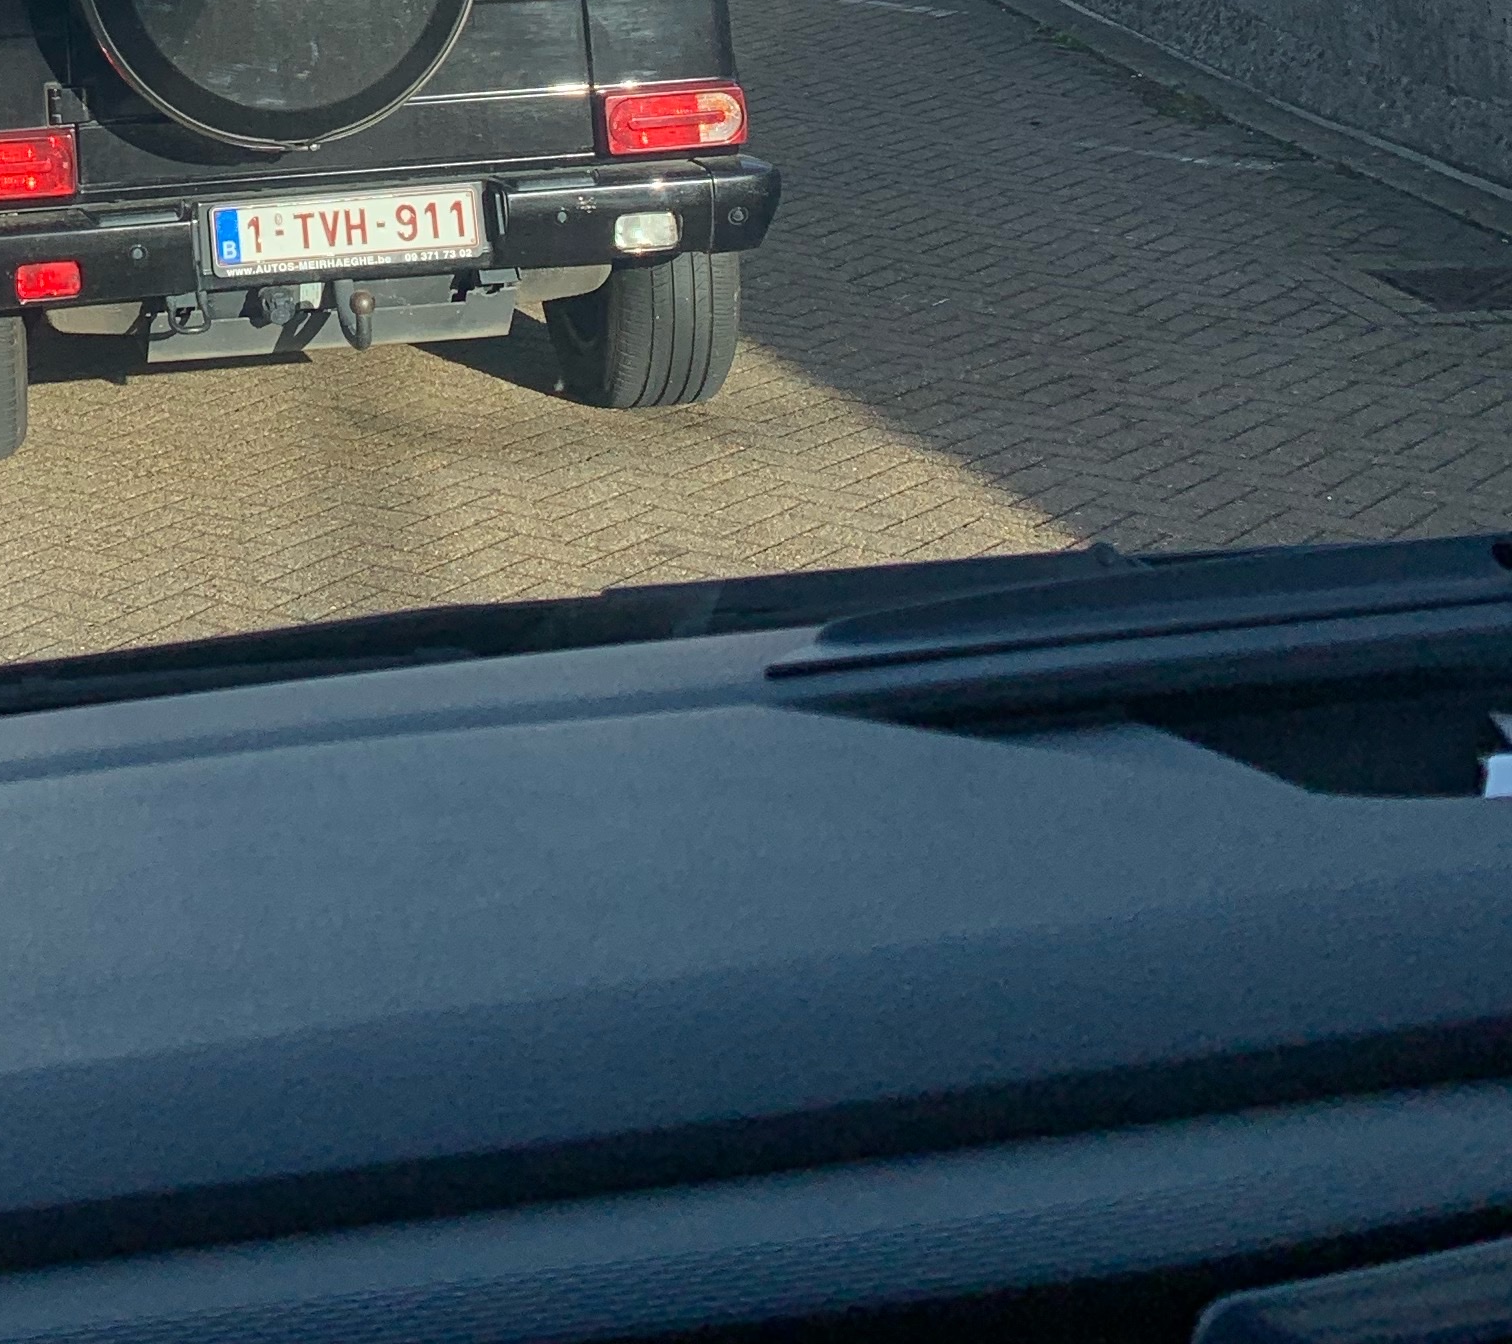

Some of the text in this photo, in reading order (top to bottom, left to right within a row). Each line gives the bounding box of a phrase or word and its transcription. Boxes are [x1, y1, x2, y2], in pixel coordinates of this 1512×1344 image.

[222, 240, 237, 259] B
[404, 252, 418, 262] 09
[420, 250, 439, 260] 371
[443, 249, 456, 259] 73
[459, 248, 473, 258] 02
